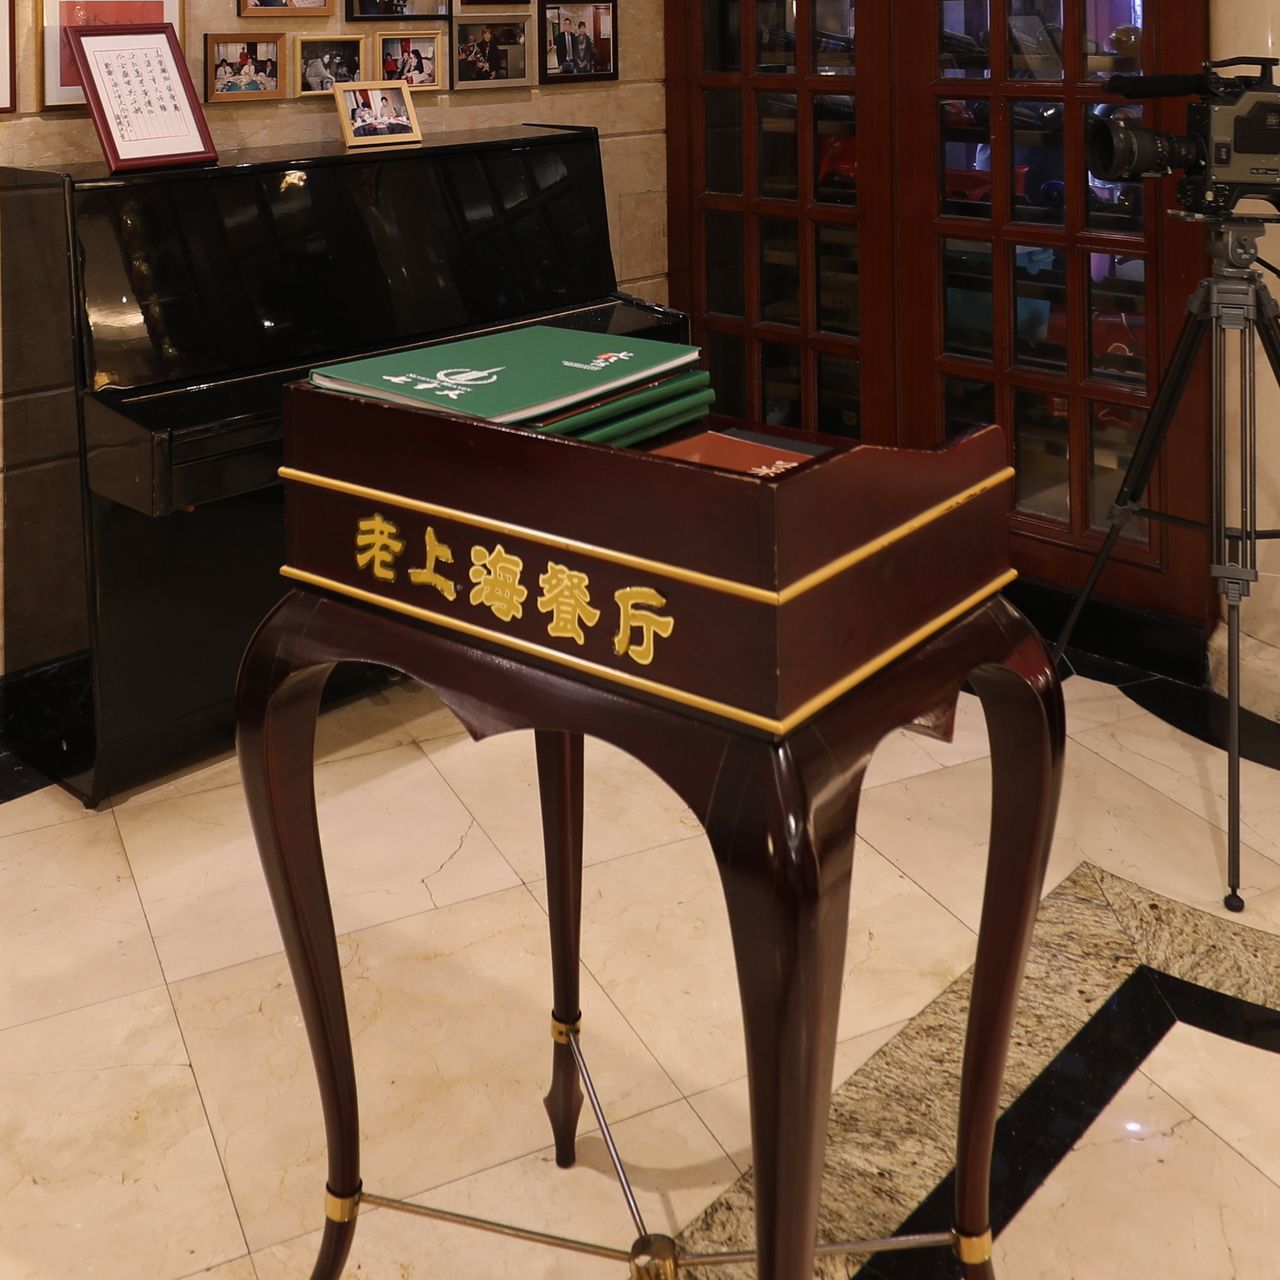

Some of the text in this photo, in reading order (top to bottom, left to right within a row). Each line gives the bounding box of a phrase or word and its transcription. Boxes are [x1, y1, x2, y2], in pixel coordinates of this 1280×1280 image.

[355, 512, 675, 666] 老上海餐厅
